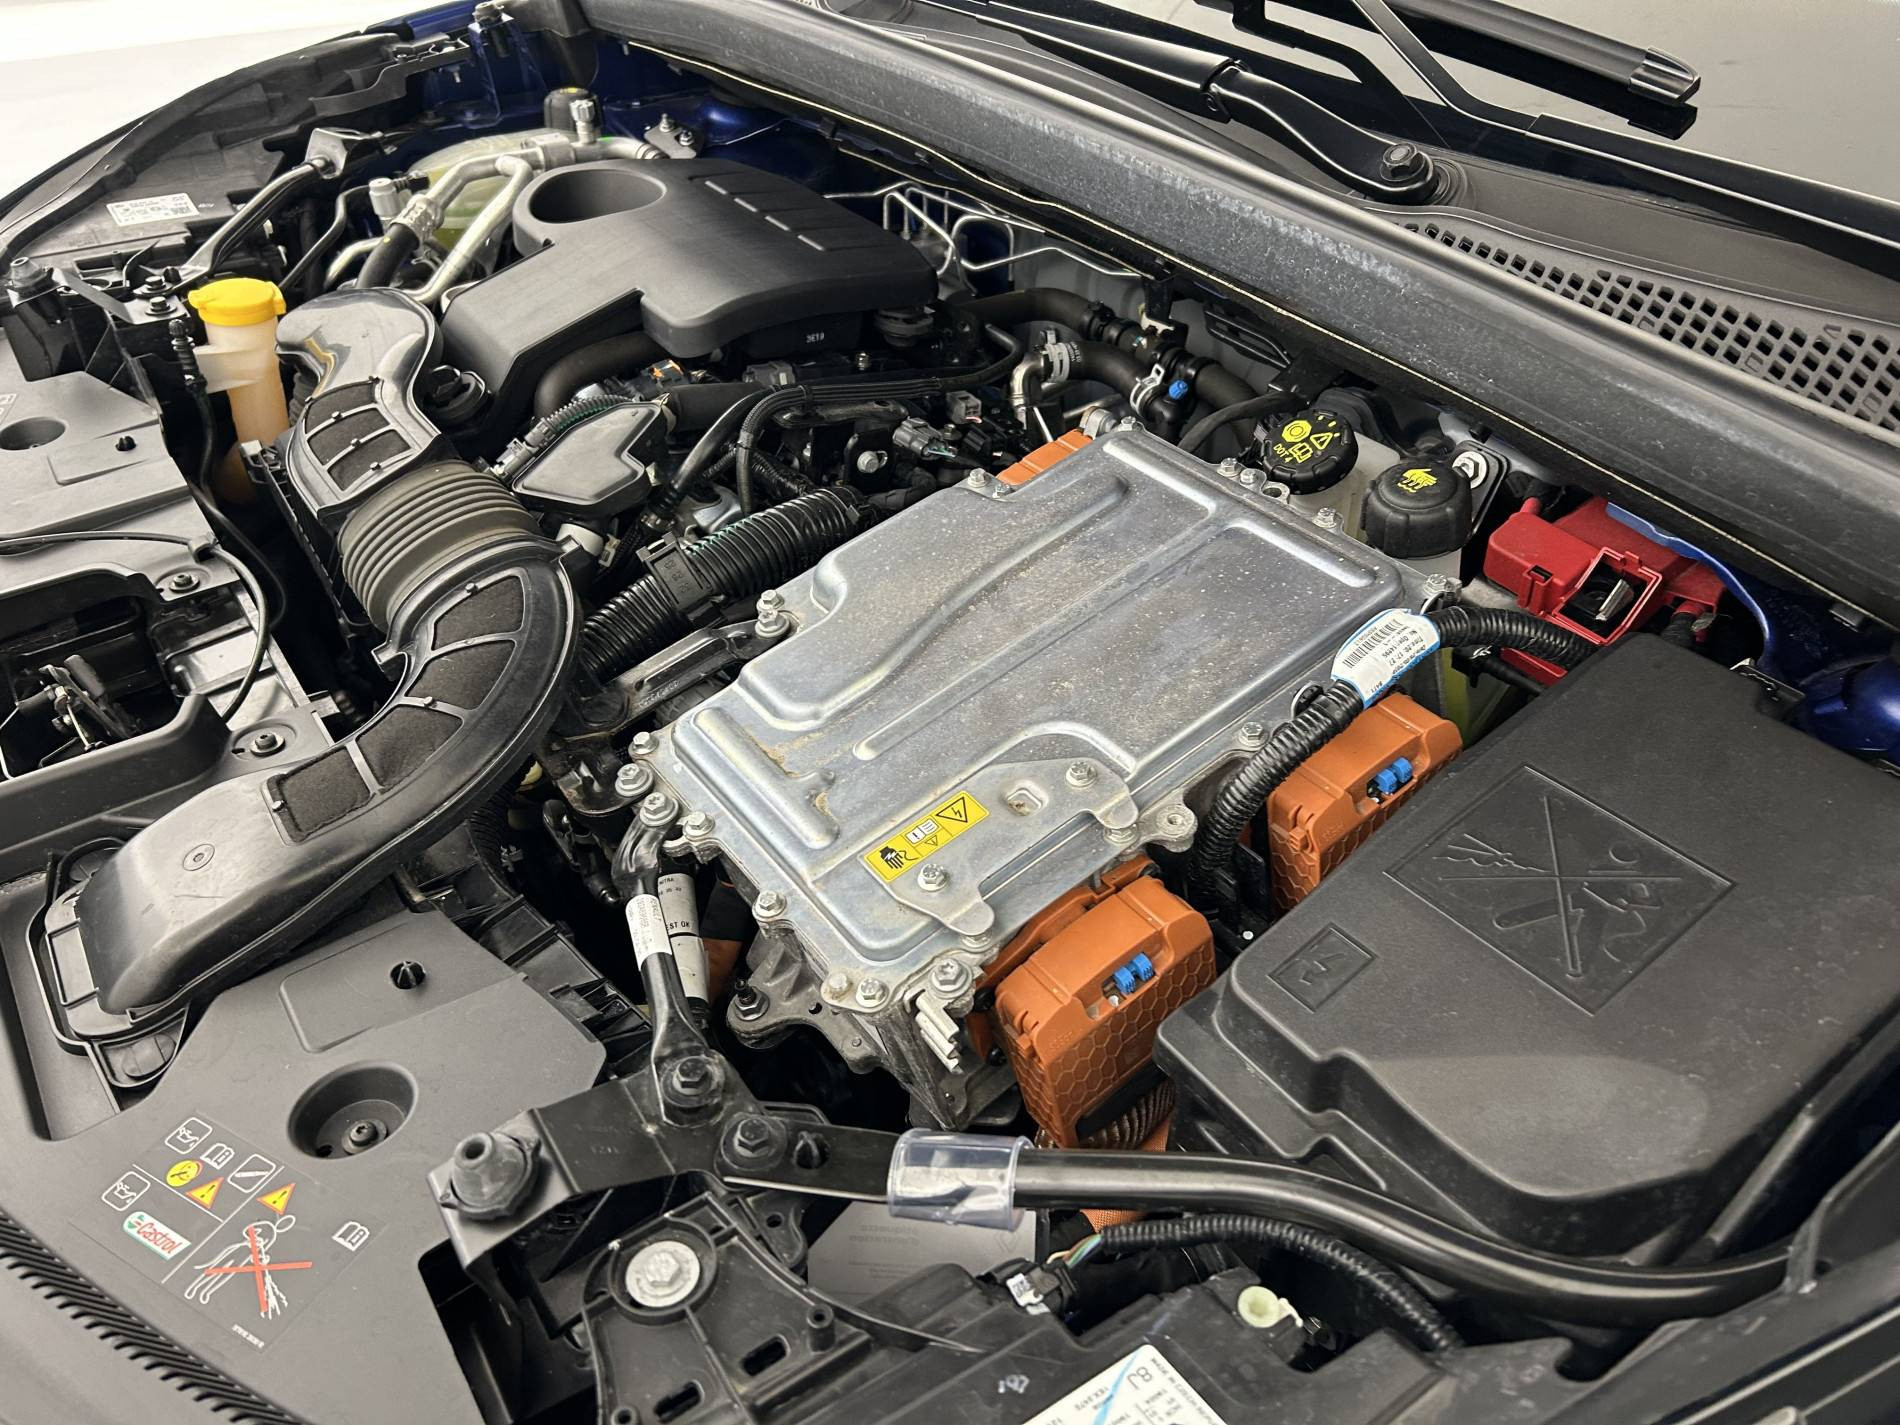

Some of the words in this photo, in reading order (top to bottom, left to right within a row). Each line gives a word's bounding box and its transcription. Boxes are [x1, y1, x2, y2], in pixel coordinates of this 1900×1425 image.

[1273, 443, 1290, 458] DOT
[680, 920, 690, 928] OK
[136, 1222, 183, 1255] Castrol
